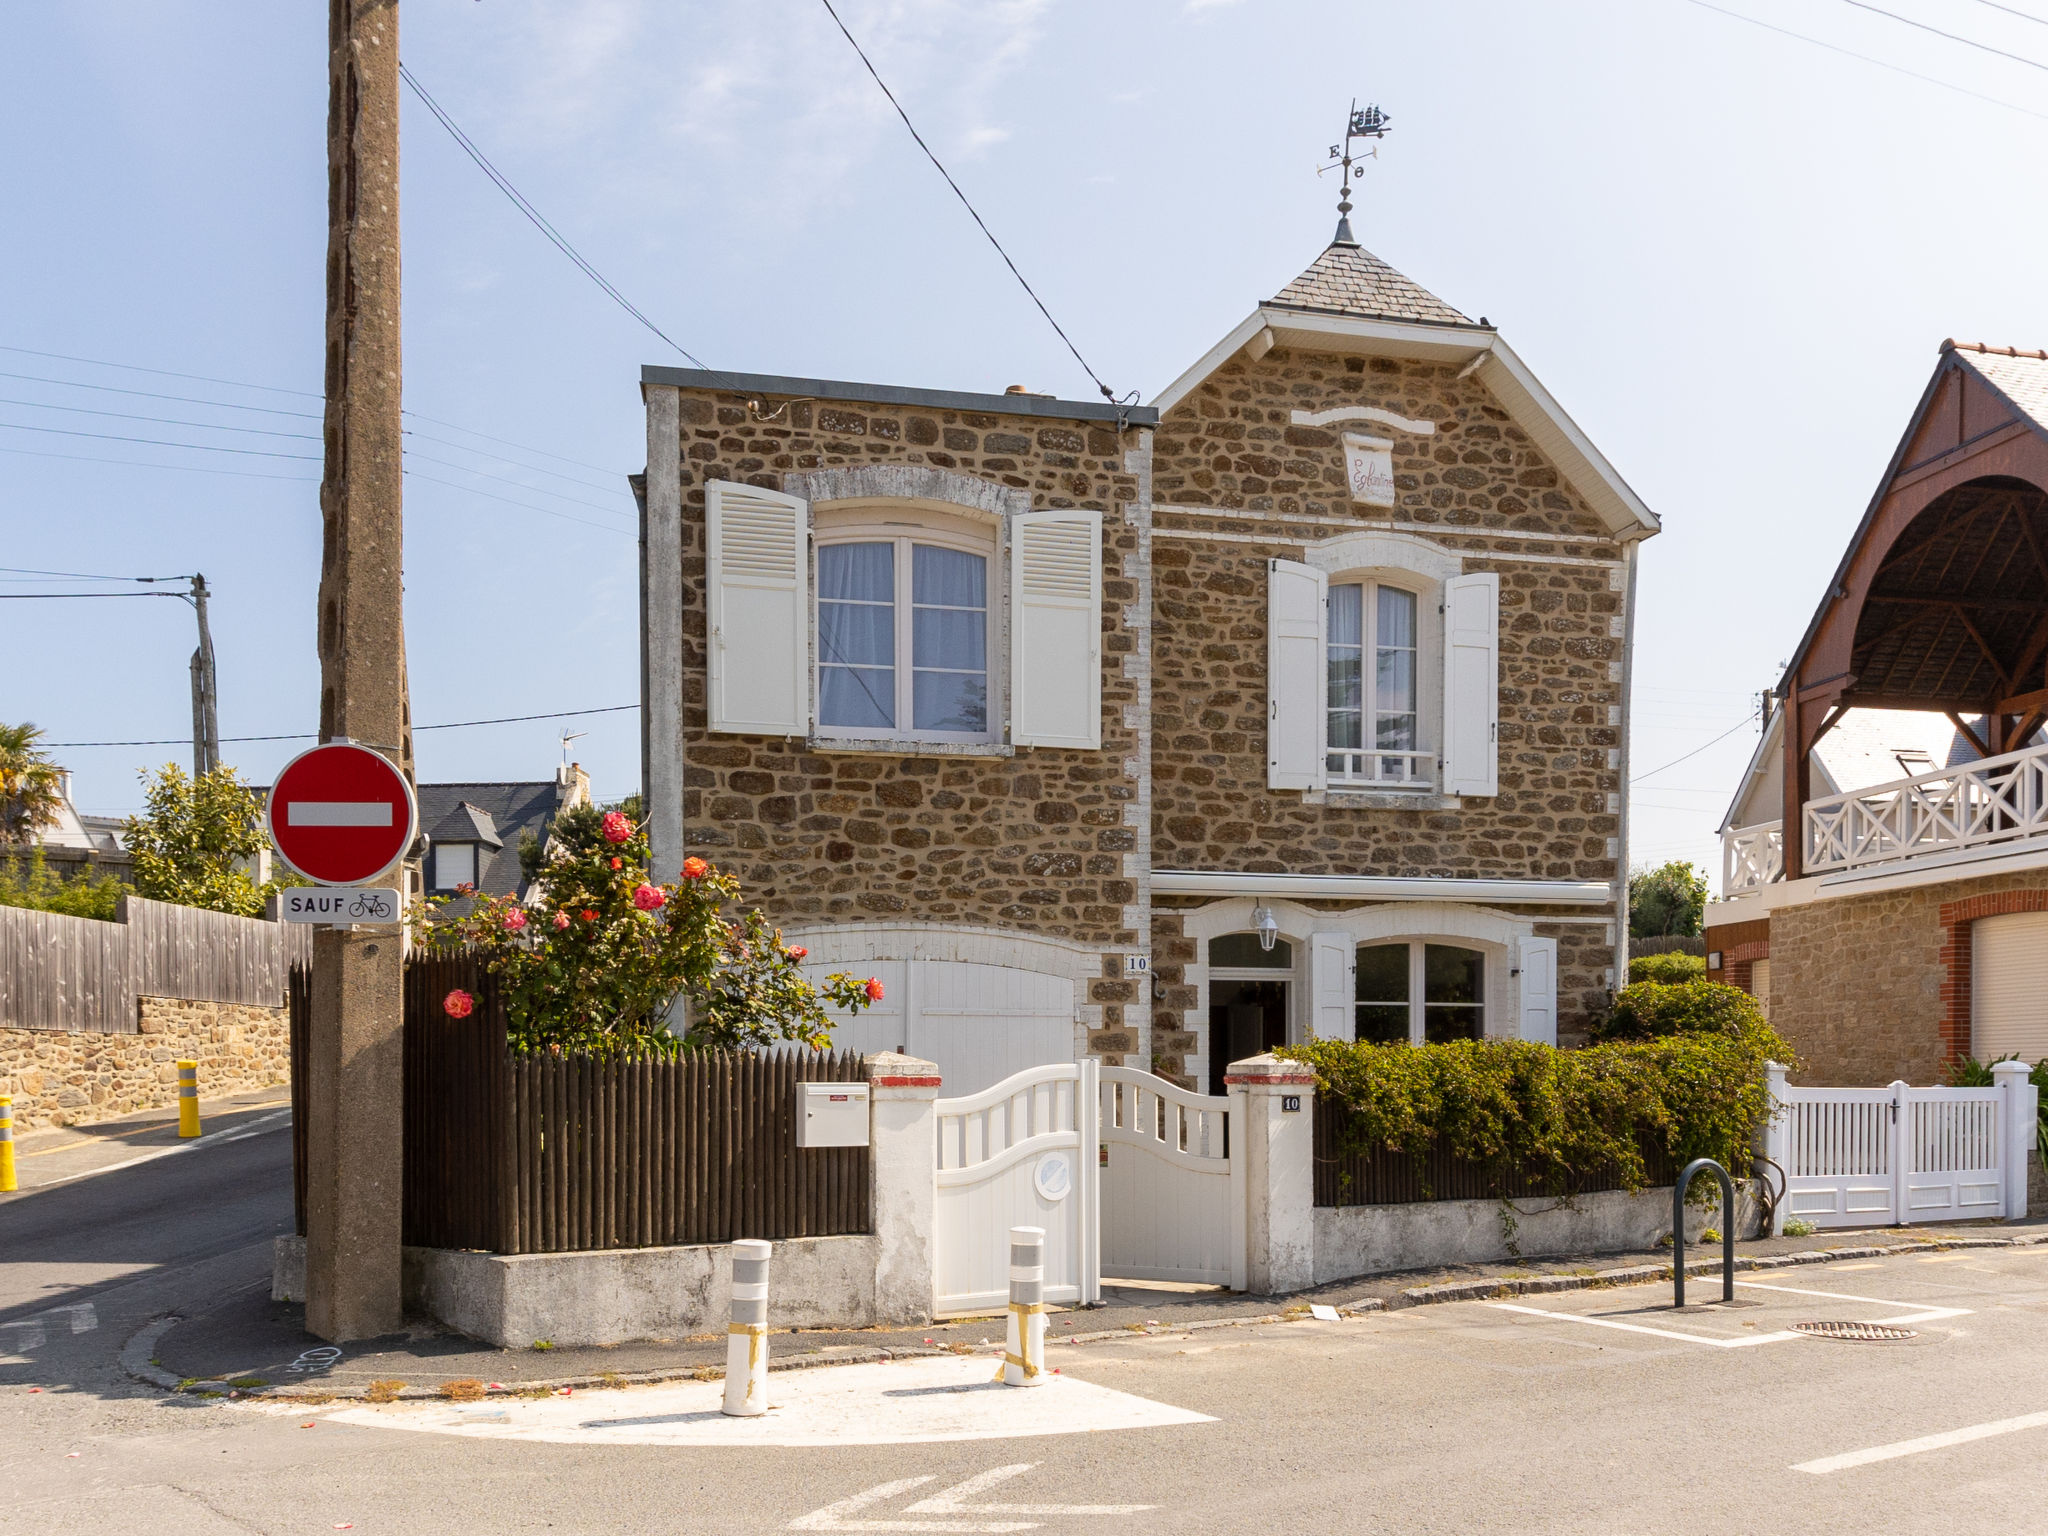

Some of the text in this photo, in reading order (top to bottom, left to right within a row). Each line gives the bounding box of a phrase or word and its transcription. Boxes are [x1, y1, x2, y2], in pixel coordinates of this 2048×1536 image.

[1329, 145, 1340, 158] E
[290, 897, 344, 913] SAUF
[1130, 958, 1147, 970] 10
[1285, 1098, 1298, 1110] 10
